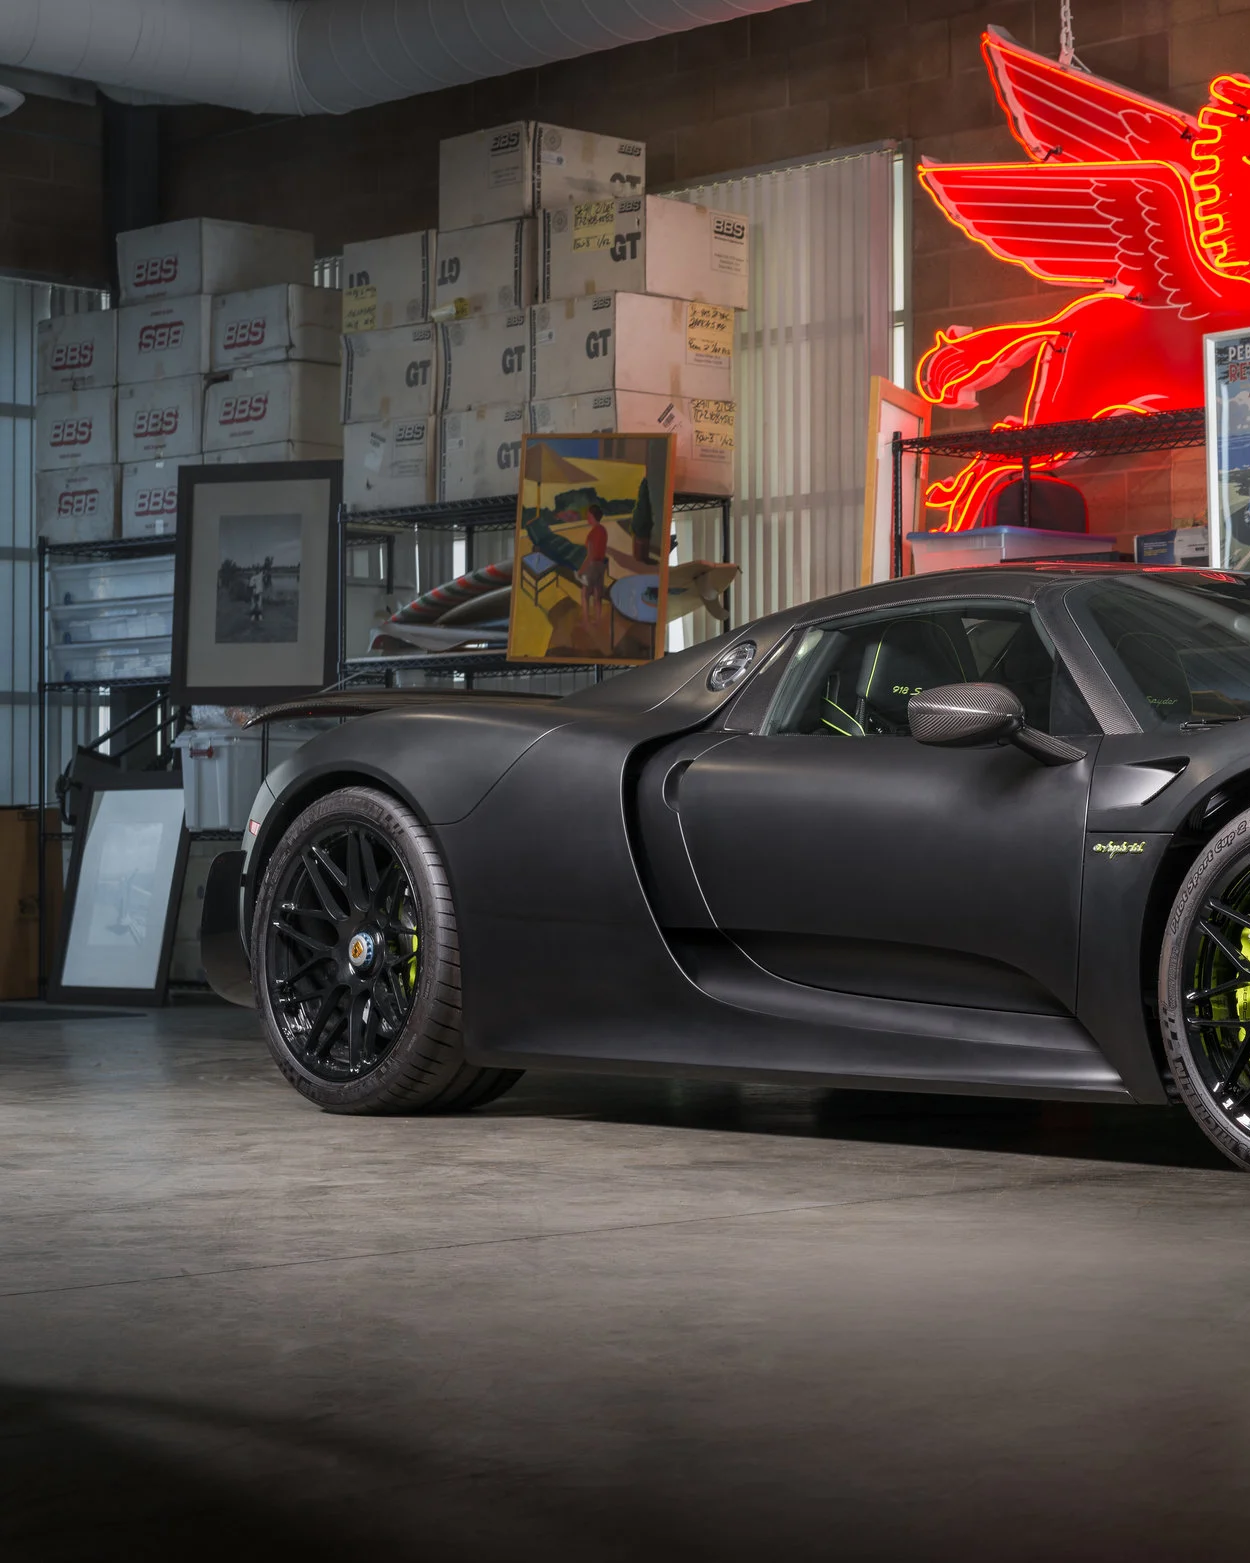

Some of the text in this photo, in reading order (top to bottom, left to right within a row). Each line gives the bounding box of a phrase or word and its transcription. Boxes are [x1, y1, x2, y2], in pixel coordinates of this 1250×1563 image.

[490, 131, 520, 152] BBS
[618, 143, 641, 157] BBS
[619, 200, 641, 214] BBS
[713, 219, 745, 240] BBS
[610, 232, 641, 263] GT
[134, 256, 178, 287] BBS
[438, 257, 460, 286] GT
[592, 298, 612, 310] BBS
[223, 319, 265, 350] BBS
[412, 329, 431, 342] BBS
[506, 315, 525, 327] BBS
[139, 321, 185, 354] BBS
[586, 328, 611, 359] GT
[51, 342, 94, 371] BBS
[502, 346, 526, 375] GT
[405, 360, 431, 387] GT
[219, 393, 269, 425] BBS
[592, 397, 612, 409] BBS
[50, 419, 92, 447] BBS
[133, 407, 179, 438] BBS
[395, 423, 425, 442] BBS
[497, 441, 521, 470] GT
[57, 488, 98, 518] BBS
[135, 487, 178, 516] BBS
[893, 685, 909, 694] 918
[1171, 820, 1247, 934] Pilot Sport Cup 2
